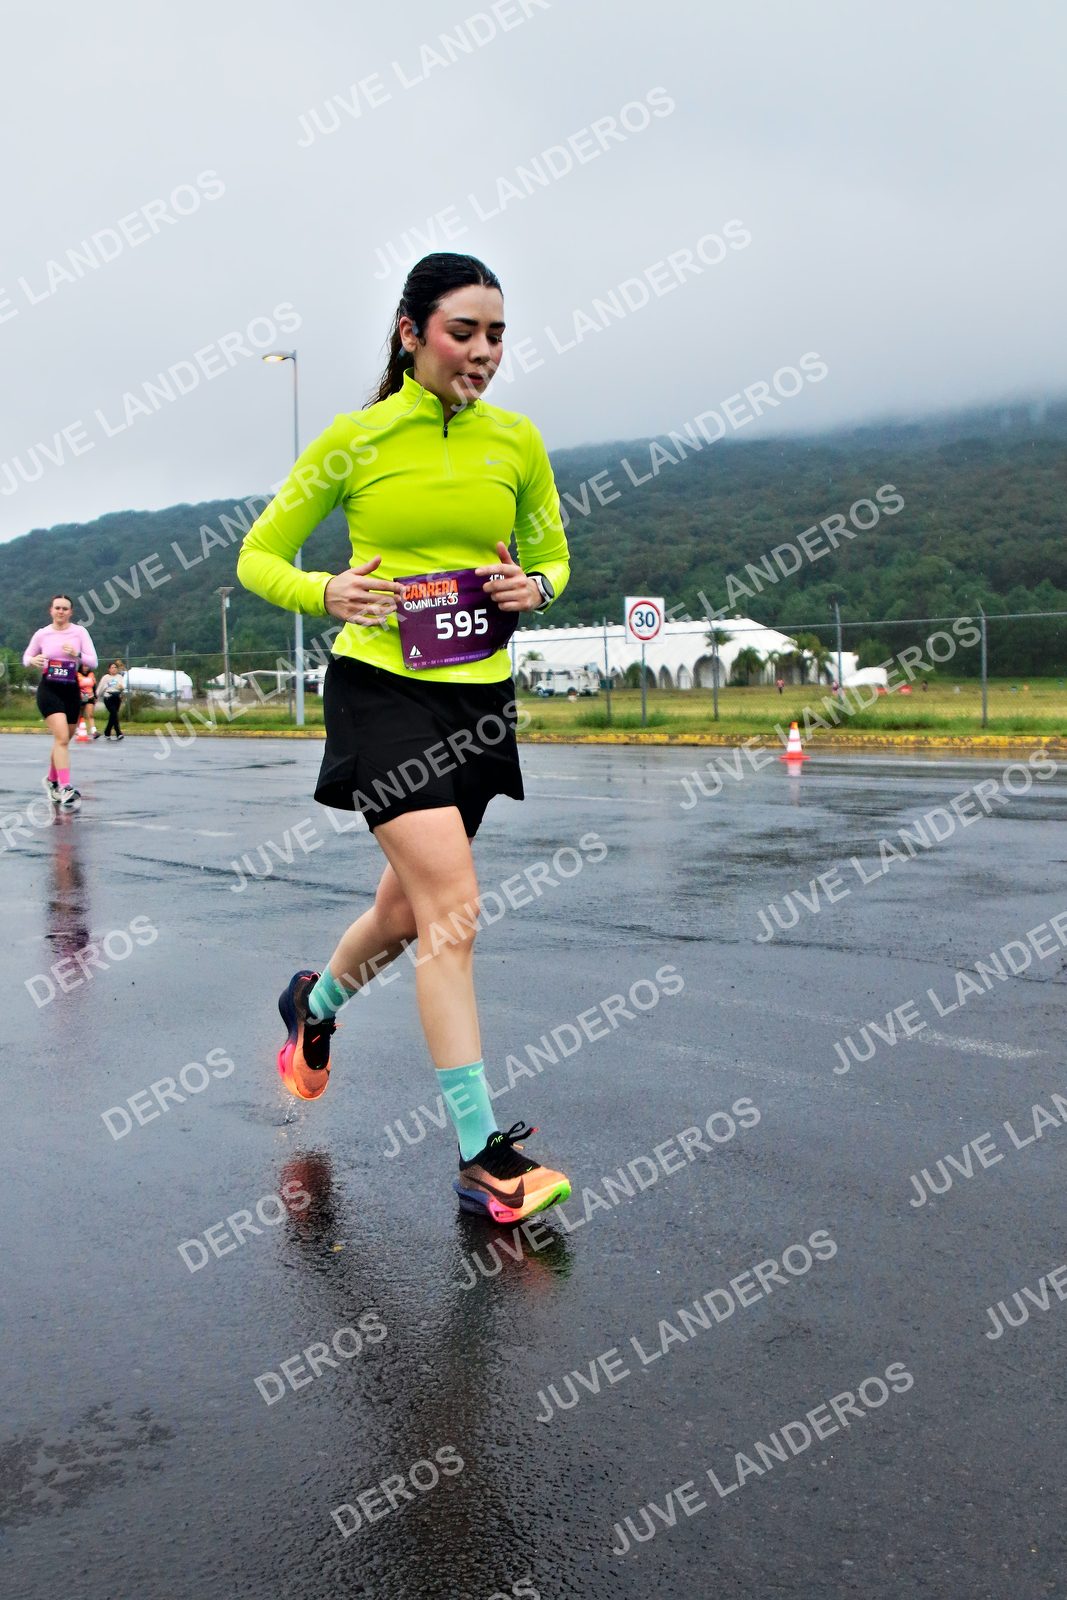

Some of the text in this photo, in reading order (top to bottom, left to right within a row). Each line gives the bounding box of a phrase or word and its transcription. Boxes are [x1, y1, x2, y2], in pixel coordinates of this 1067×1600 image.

[403, 578, 458, 600] CARRERA
[404, 598, 447, 611] OMNILIFE
[435, 608, 489, 640] 595
[635, 611, 655, 628] 30
[53, 667, 69, 676] 325
